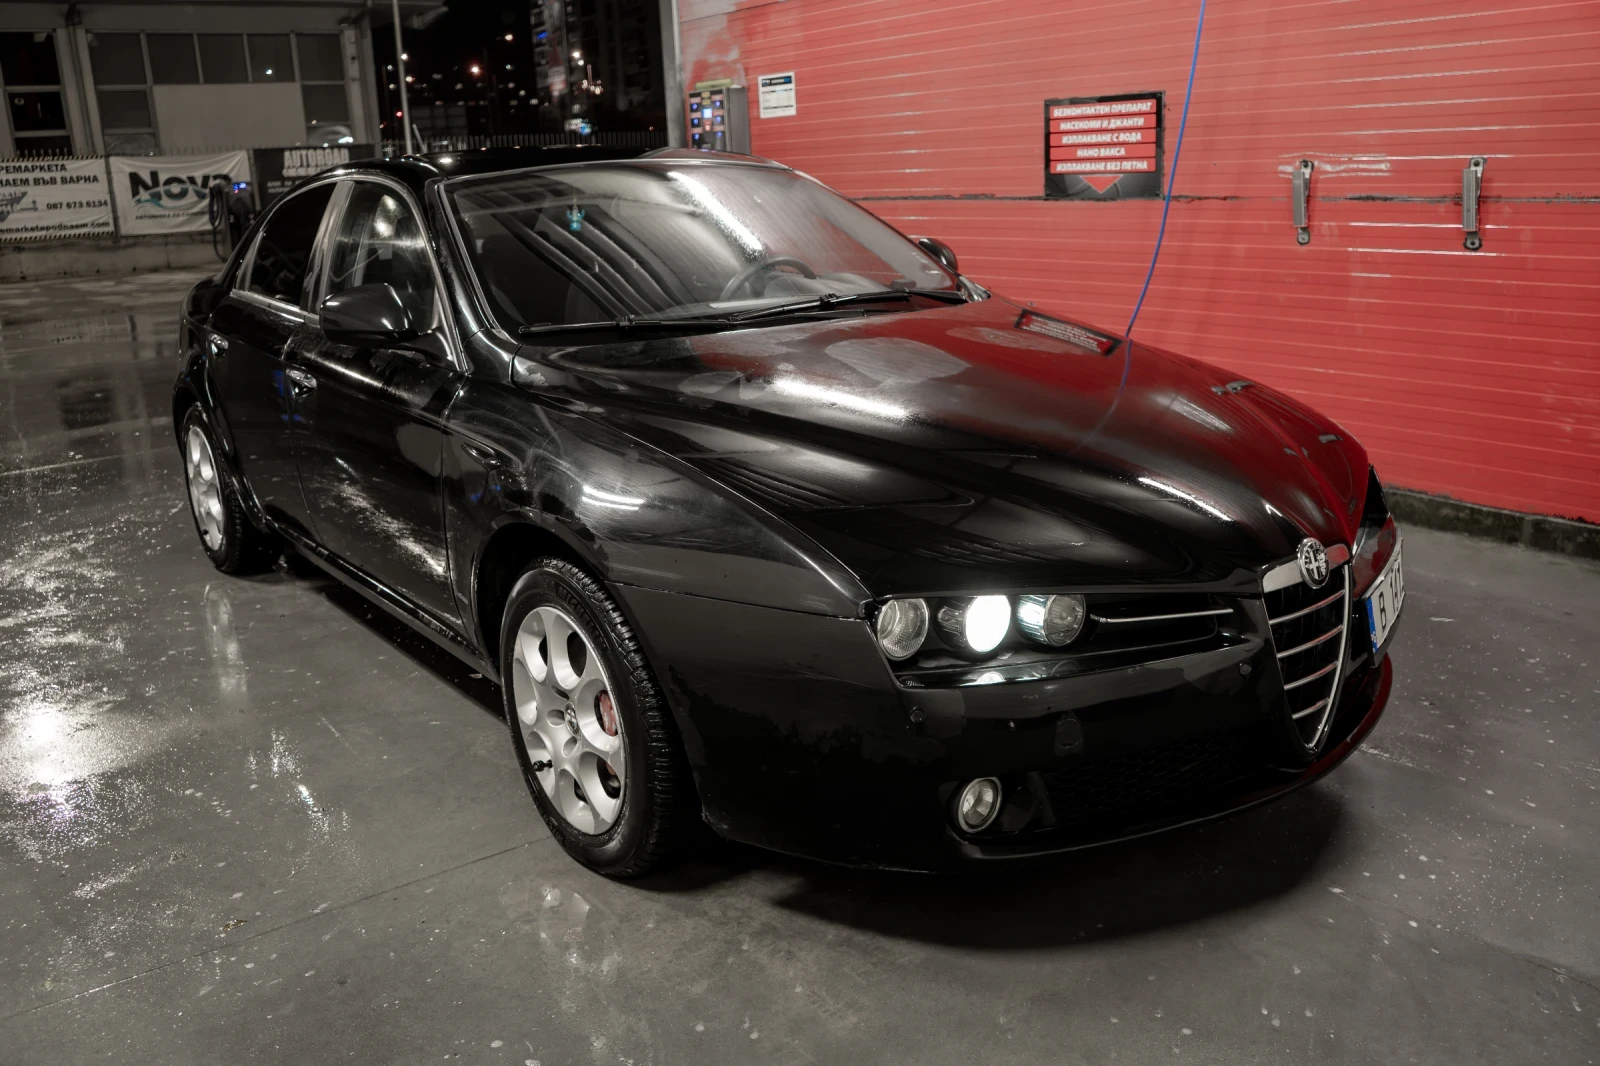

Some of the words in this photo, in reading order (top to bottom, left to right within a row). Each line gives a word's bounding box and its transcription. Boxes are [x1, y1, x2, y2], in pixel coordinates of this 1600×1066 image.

[1053, 106, 1110, 117] БЕЗКОНТАКТЕН
[1111, 102, 1152, 113] ПРЕПАРАТ
[1060, 121, 1101, 130] НАСЕКОМИ
[1102, 120, 1108, 128] И
[1109, 117, 1144, 129] ДЖАНТИ
[1062, 134, 1112, 144] ИЗПЛАКВАНЕ
[1113, 133, 1119, 142] С
[1120, 132, 1142, 142] ВОДА
[284, 147, 350, 169] AUTOROAD
[1077, 148, 1099, 157] НАНО
[1100, 147, 1126, 156] ВАКСА
[0, 163, 68, 174] РЕМАРКЕТА
[1056, 162, 1106, 172] ИЗПЛАКВАНЕ
[1106, 161, 1121, 170] БЕЗ
[1122, 160, 1148, 170] ПЕТНА
[33, 176, 57, 186] ВЪВ
[60, 174, 100, 185] ВАРНА
[46, 202, 63, 210] 087
